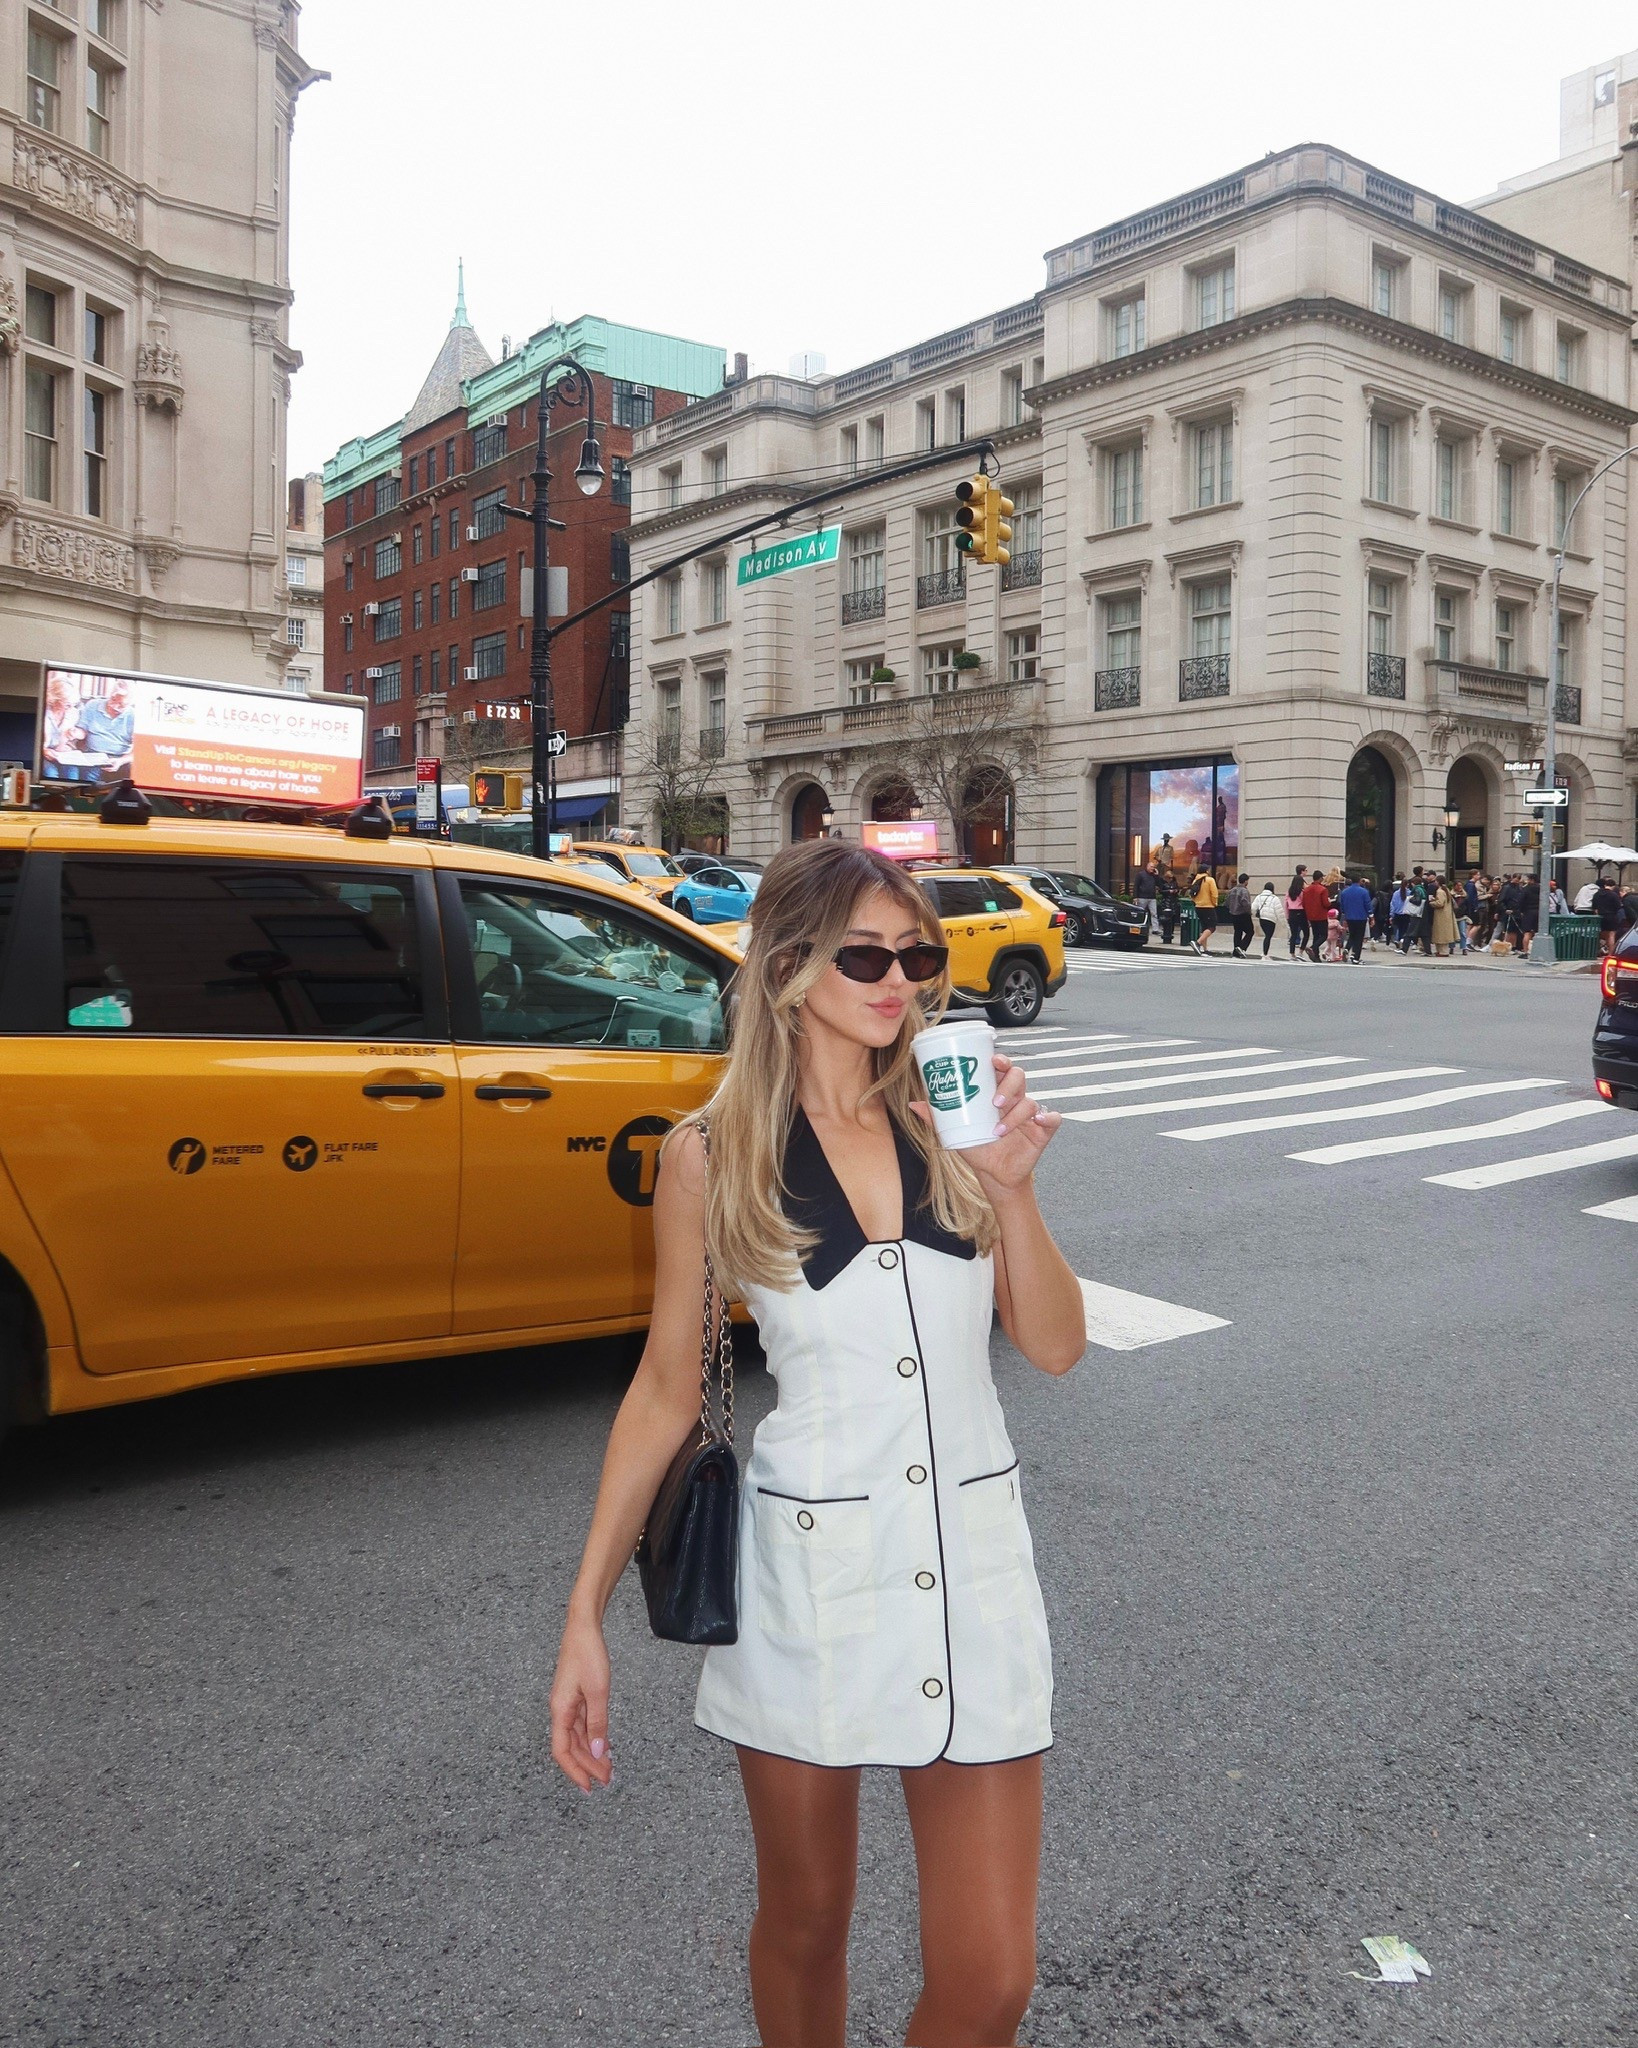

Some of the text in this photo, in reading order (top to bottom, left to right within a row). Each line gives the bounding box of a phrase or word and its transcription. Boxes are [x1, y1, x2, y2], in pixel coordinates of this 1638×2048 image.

[745, 541, 827, 578] Madison Av
[486, 704, 521, 720] E 72 St
[206, 706, 217, 718] A
[223, 708, 281, 726] LEGACY
[286, 716, 306, 728] OF
[311, 719, 350, 734] HOPE
[1453, 725, 1516, 740] ALPH LAUREN
[153, 744, 176, 756] Visit
[170, 759, 322, 783] to learn more about how you
[1504, 761, 1541, 771] Madison Av
[173, 772, 196, 782] can
[198, 773, 228, 785] leave
[230, 777, 239, 786] a
[240, 777, 277, 791] legacy
[279, 782, 290, 791] of
[369, 1047, 437, 1056] PULL AND SLIDE
[212, 1144, 264, 1155] METERED
[324, 1142, 378, 1152] FLAT FARE
[566, 1136, 606, 1152] NYC
[212, 1156, 241, 1166] FARE
[323, 1154, 344, 1163] JFK
